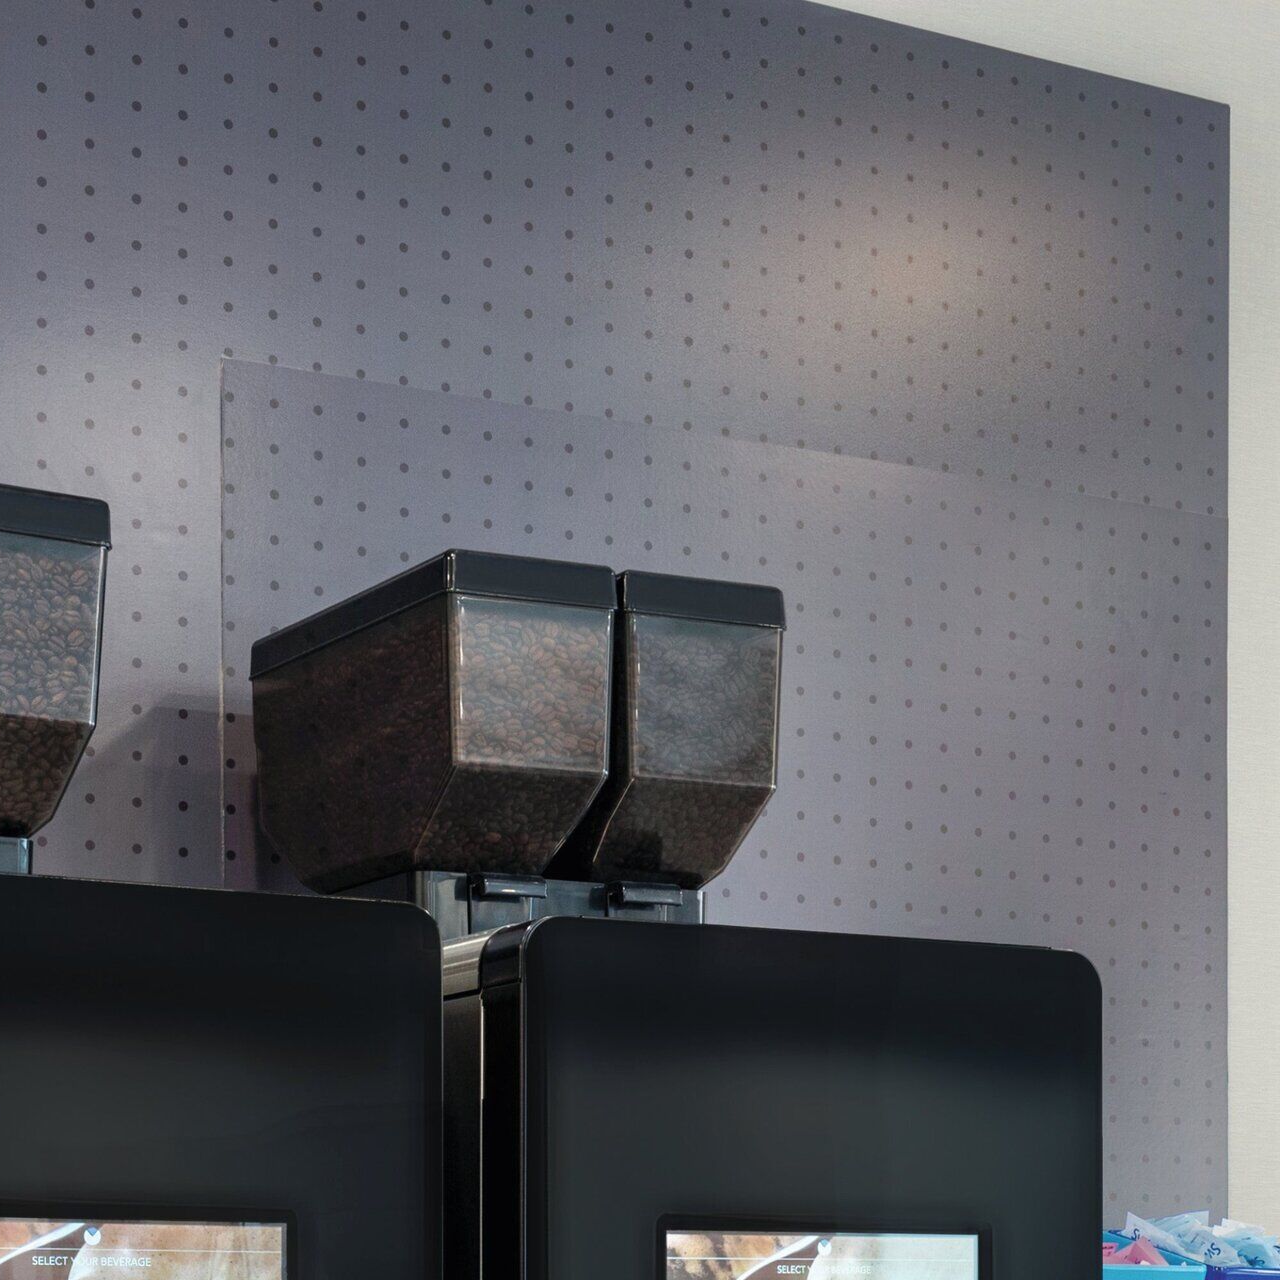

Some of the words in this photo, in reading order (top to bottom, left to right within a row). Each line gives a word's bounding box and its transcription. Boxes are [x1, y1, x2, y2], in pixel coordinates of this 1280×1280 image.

[32, 1256, 68, 1266] SELECT
[101, 1257, 152, 1267] BEVERAGE
[777, 1265, 806, 1274] SELECT
